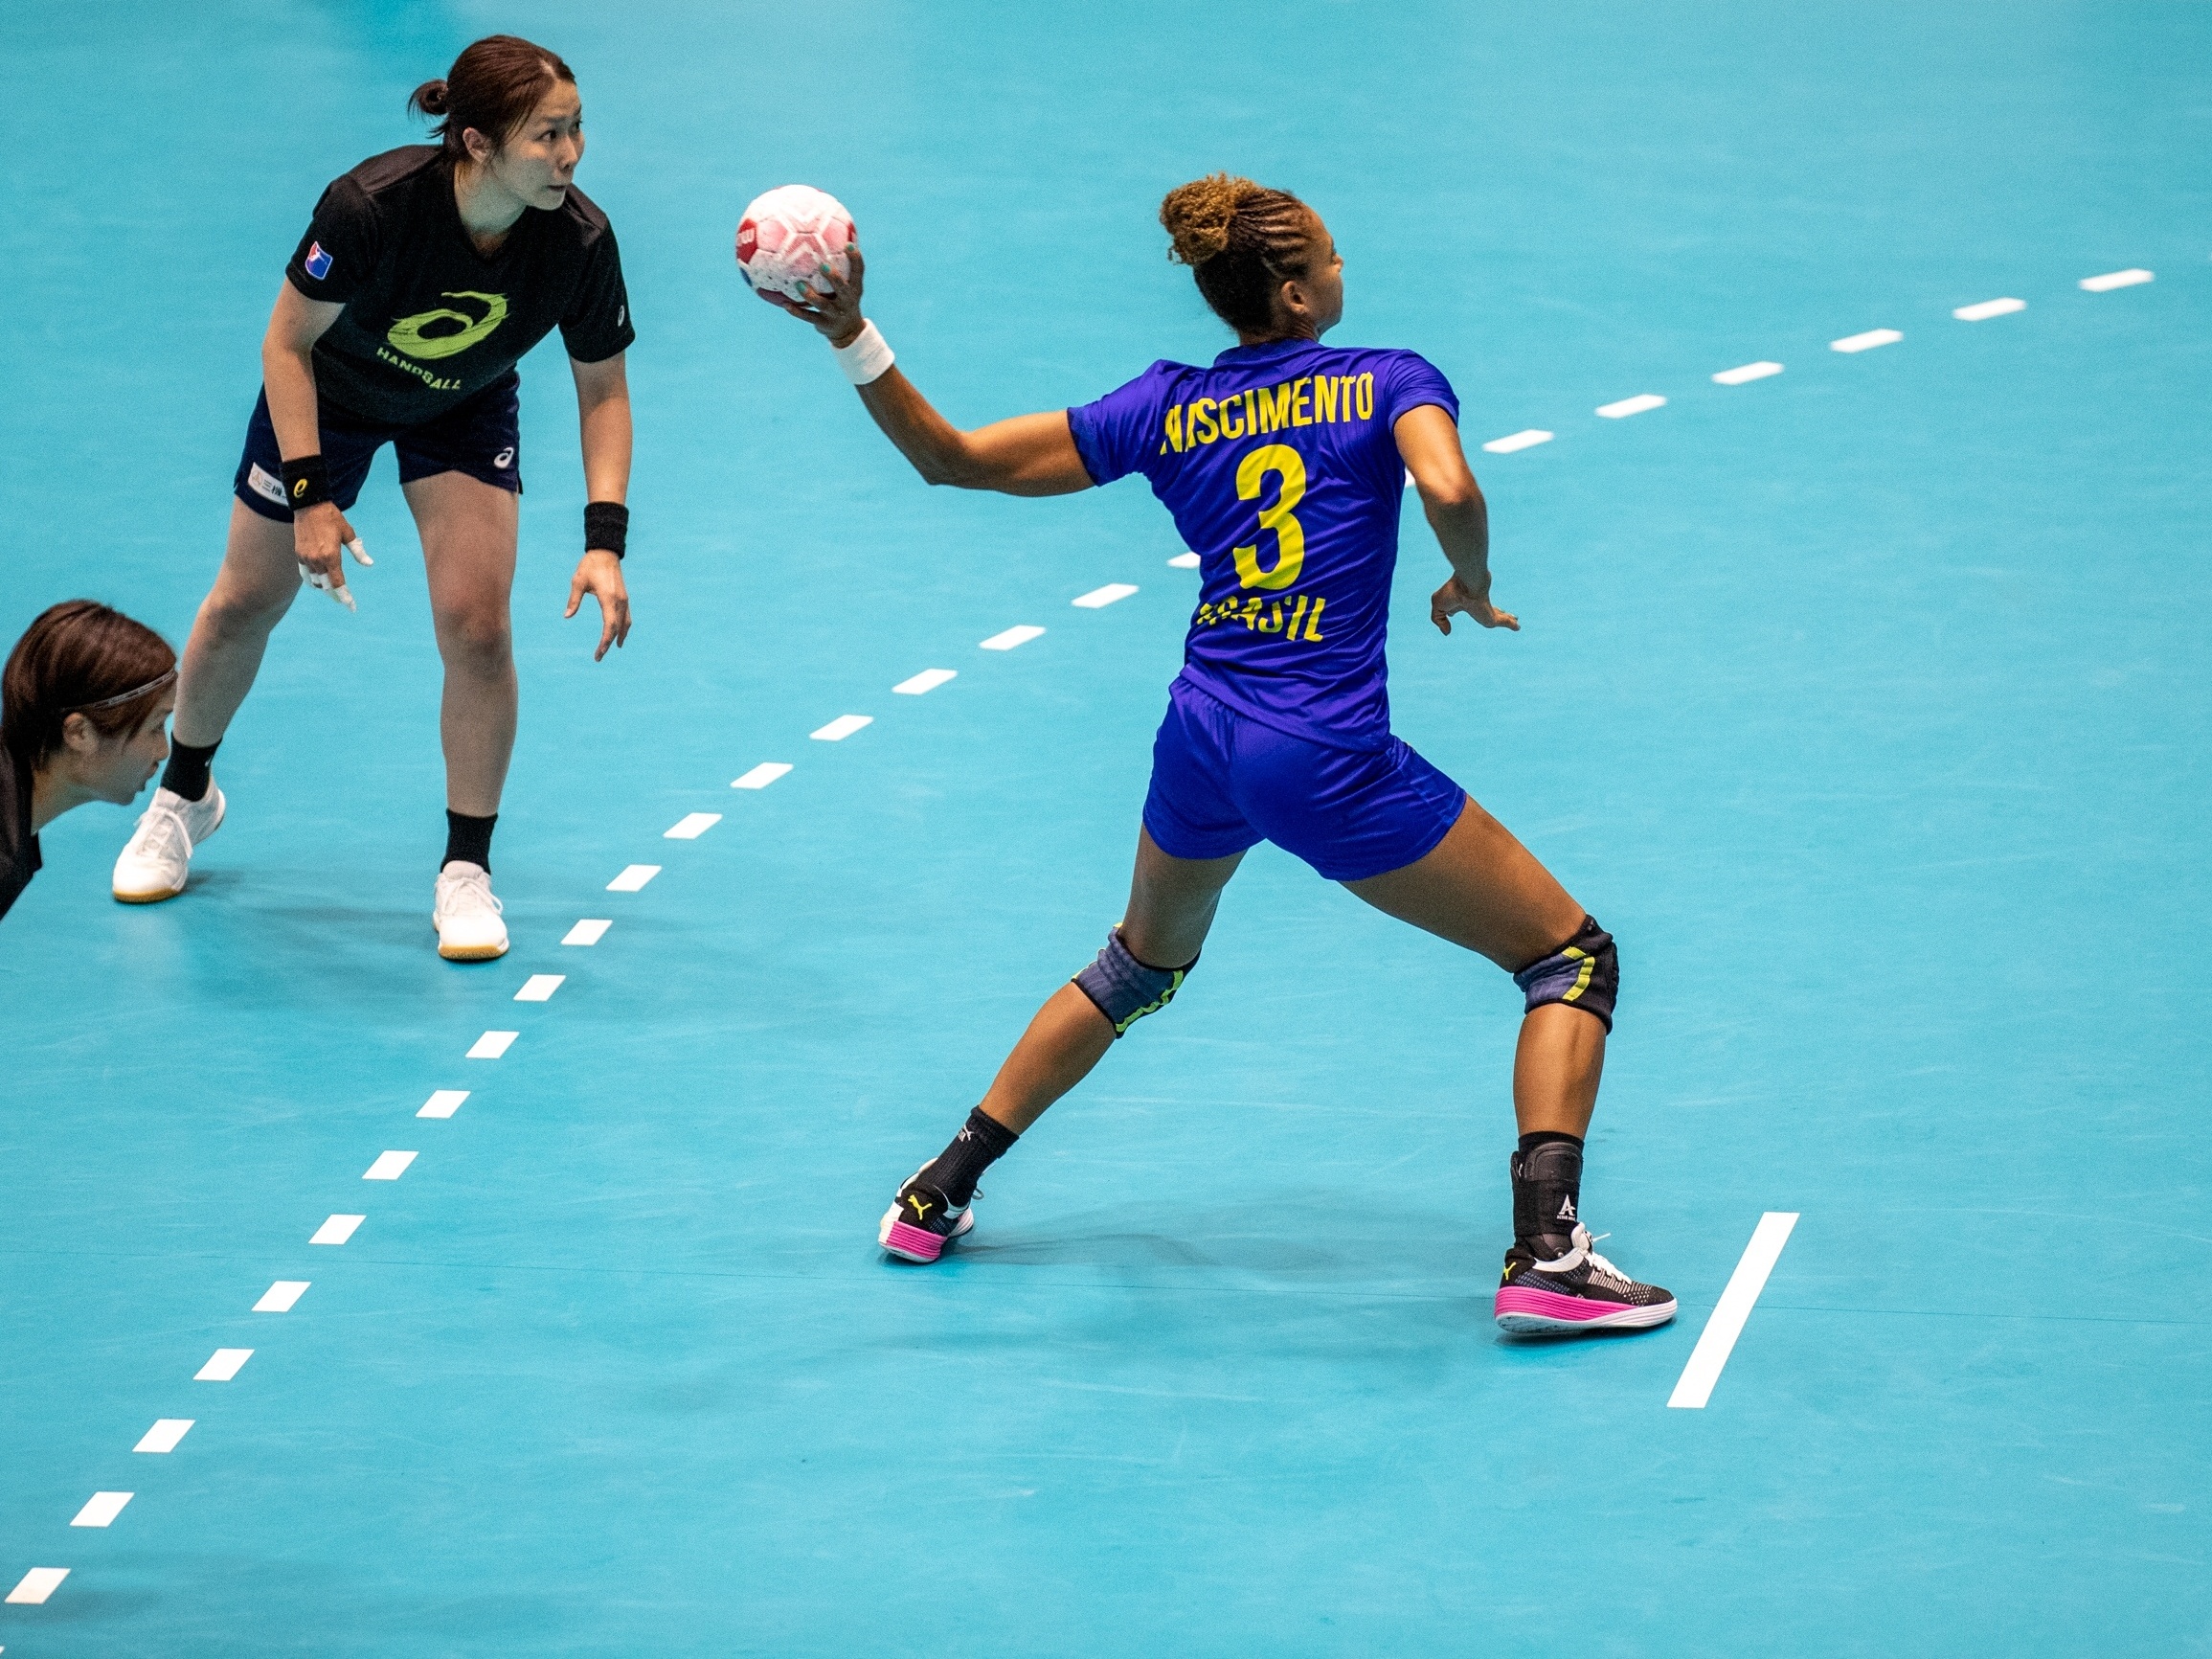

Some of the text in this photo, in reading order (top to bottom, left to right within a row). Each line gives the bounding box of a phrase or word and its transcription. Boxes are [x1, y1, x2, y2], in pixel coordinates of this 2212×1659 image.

[376, 347, 462, 390] HANDBALL
[1160, 372, 1374, 455] NASCIMENTO
[1232, 443, 1306, 591] 3
